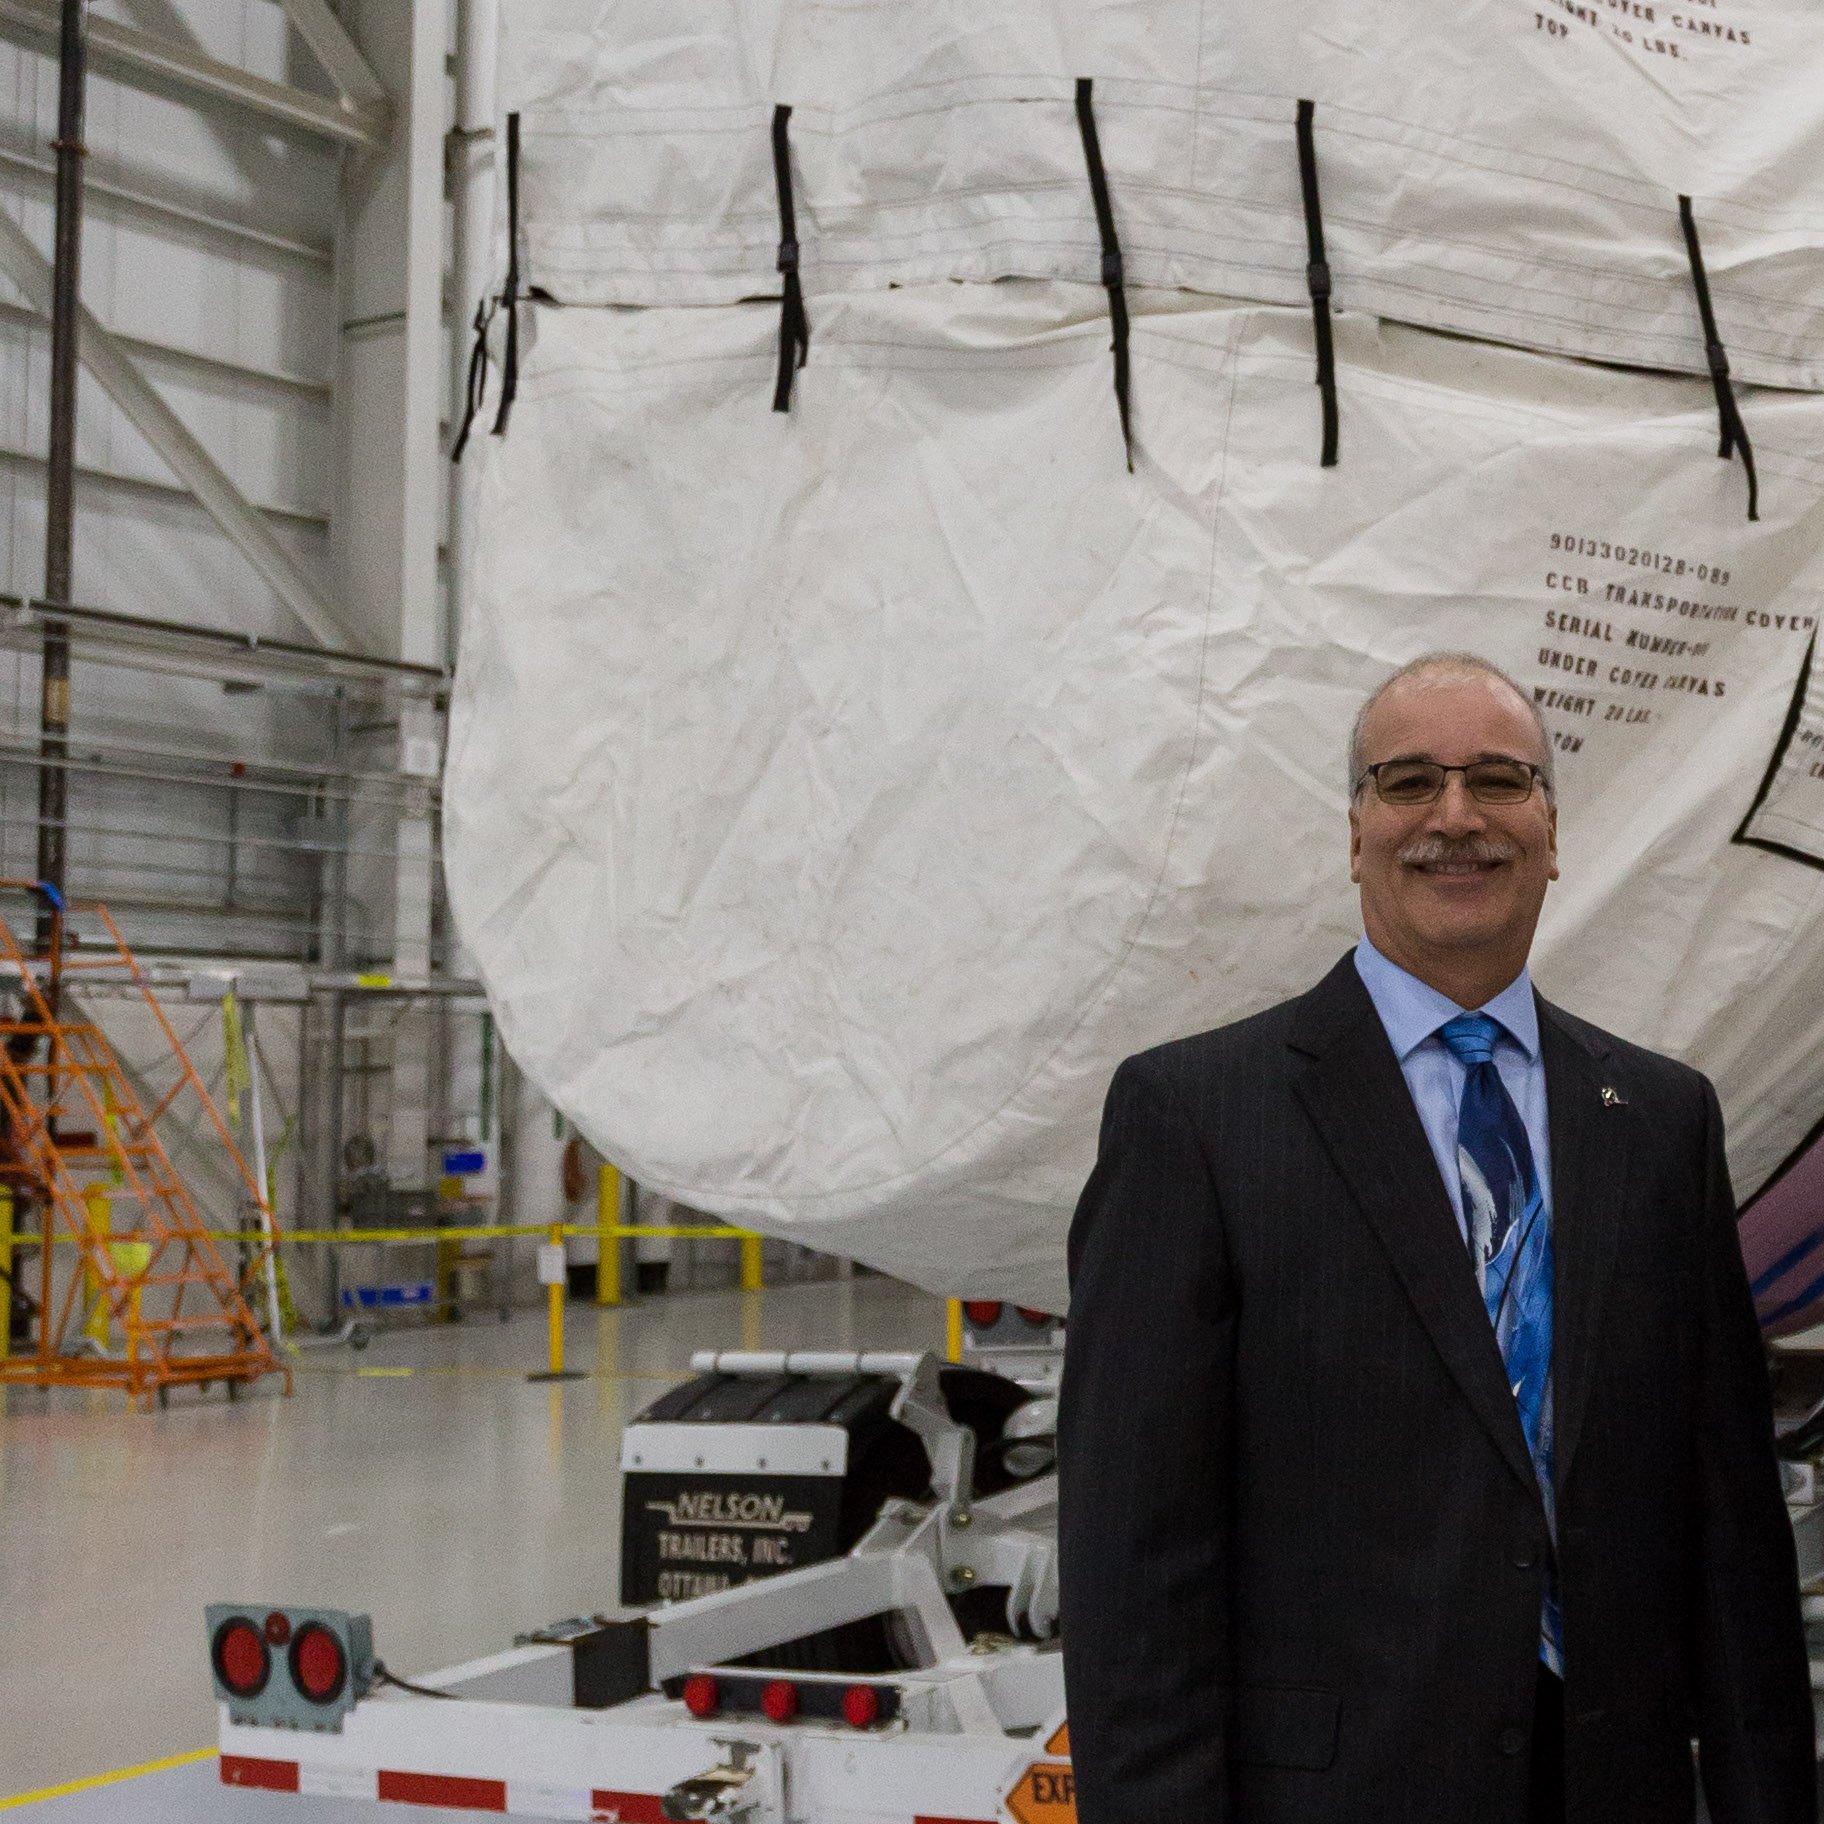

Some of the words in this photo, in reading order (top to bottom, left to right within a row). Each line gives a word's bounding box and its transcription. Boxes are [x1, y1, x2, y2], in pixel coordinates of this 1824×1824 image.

[1671, 13, 1751, 45] CANVAS
[1550, 532, 1731, 587] 90133020128-089
[1545, 609, 1613, 643] SERIAL
[1745, 609, 1814, 632] COVER
[1538, 647, 1598, 678] UNDER
[1533, 686, 1597, 718] WEIGHT
[677, 1491, 785, 1522] NELSON
[1032, 1771, 1075, 1806] EXP
